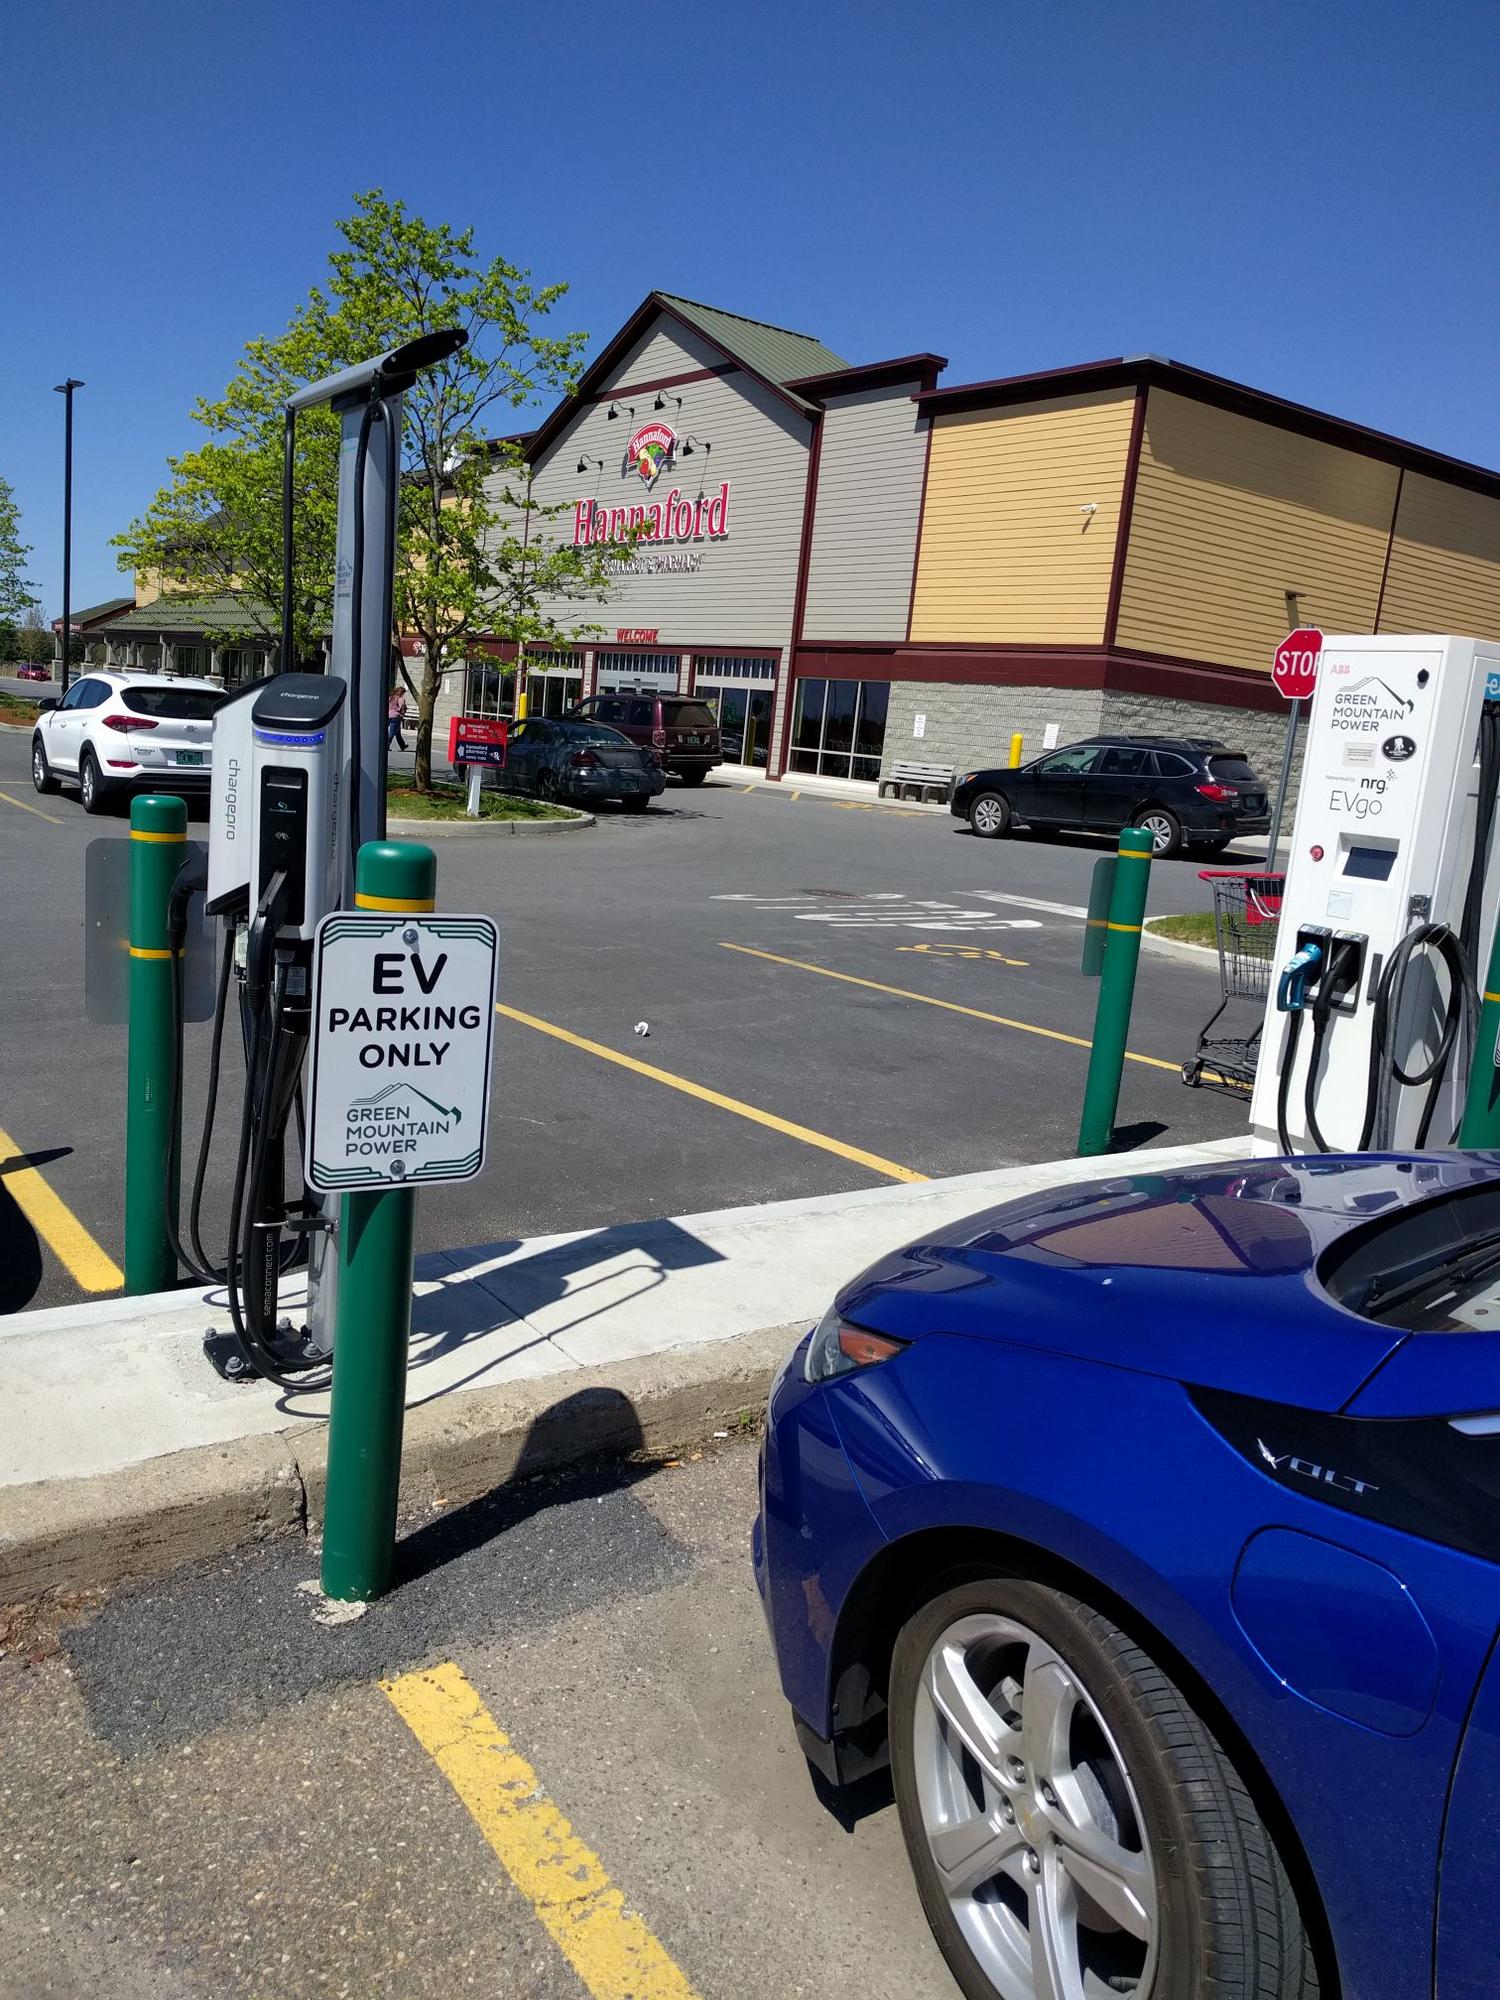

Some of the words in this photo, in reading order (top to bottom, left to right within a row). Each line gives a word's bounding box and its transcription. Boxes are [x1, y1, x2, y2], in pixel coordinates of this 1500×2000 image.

[633, 428, 672, 453] Hannaford
[572, 482, 731, 546] Hannaford
[616, 628, 660, 643] WELCOME
[1335, 693, 1377, 706] GREEN
[1333, 707, 1405, 720] MOUNTAIN
[1331, 719, 1379, 732] POWER
[1360, 777, 1386, 794] nrg
[226, 758, 241, 841] chargepro
[1329, 790, 1382, 819] EVgo
[372, 953, 448, 995] EV
[329, 1005, 481, 1033] PARKING
[358, 1042, 450, 1069] ONLY
[347, 1106, 410, 1123] GREEN
[346, 1121, 450, 1140] MOUNTAIN
[345, 1139, 417, 1157] POWER
[1257, 1437, 1380, 1496] VOLT
